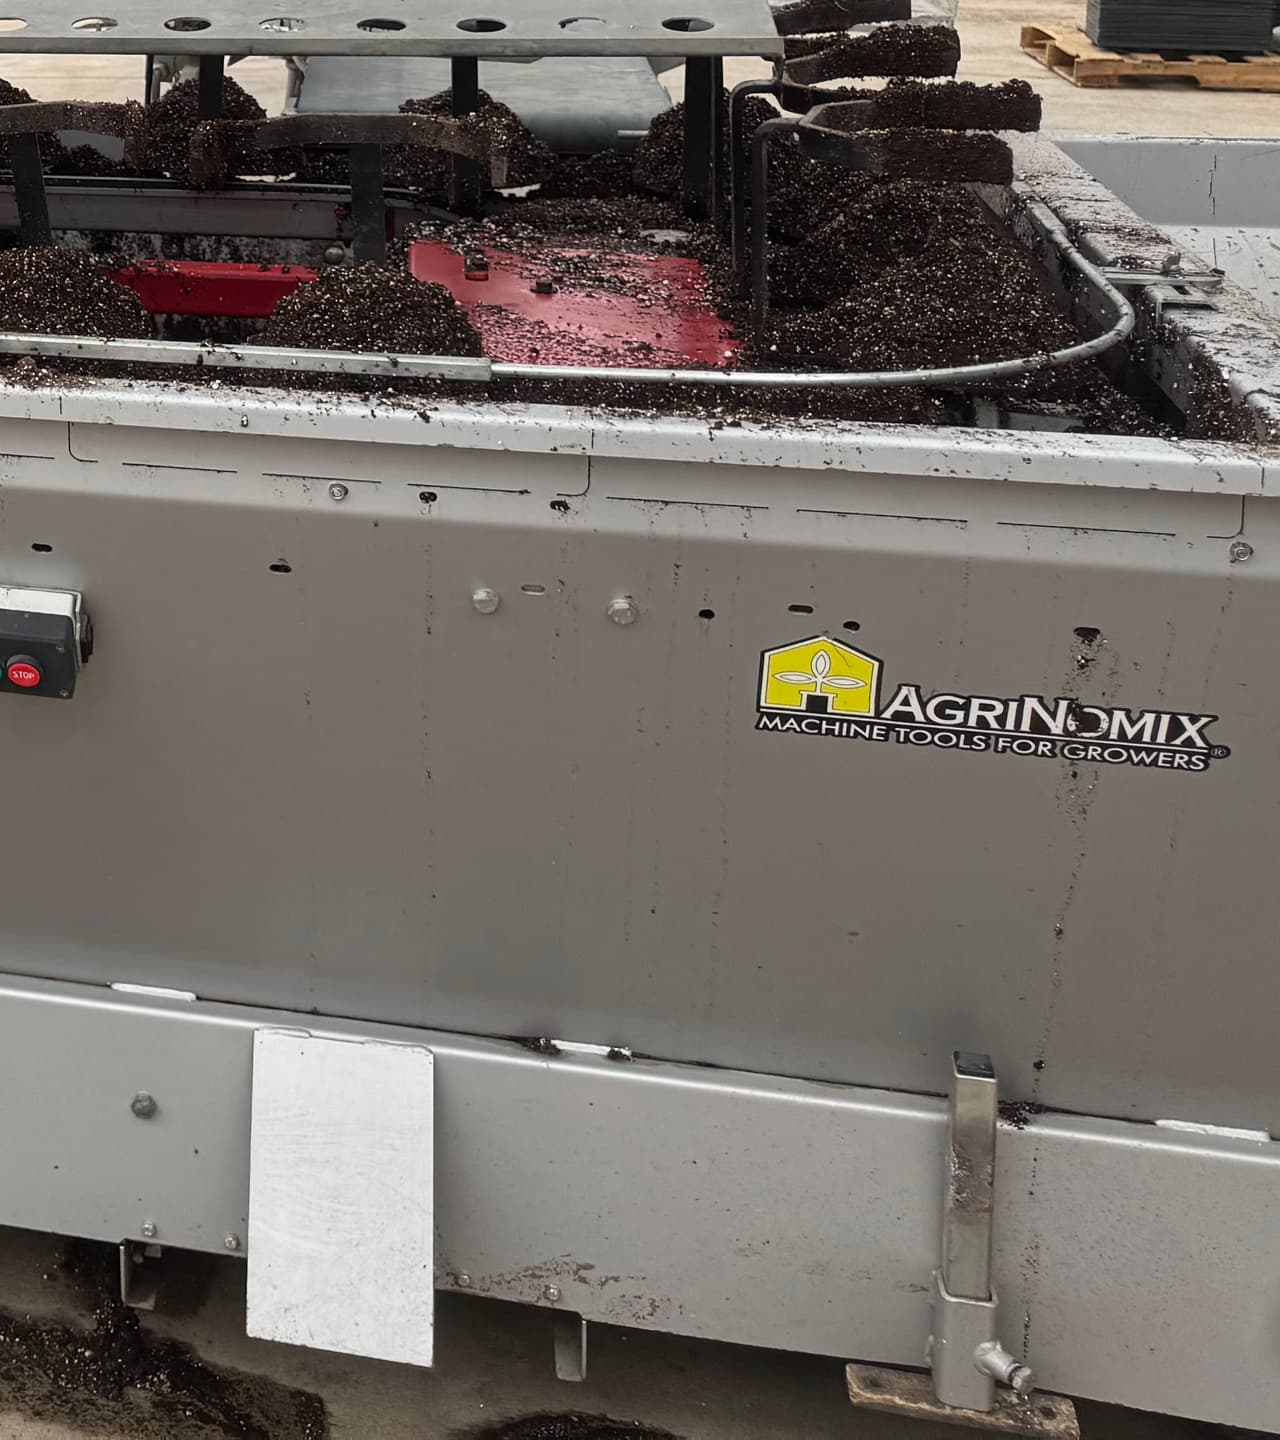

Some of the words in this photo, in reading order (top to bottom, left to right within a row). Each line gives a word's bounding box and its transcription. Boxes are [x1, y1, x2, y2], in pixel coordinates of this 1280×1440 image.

[13, 671, 35, 680] STOP
[758, 714, 887, 741] MACHINE
[894, 726, 987, 752] TOOLS
[997, 736, 1054, 758] FOR
[1062, 743, 1206, 771] GROWERS
